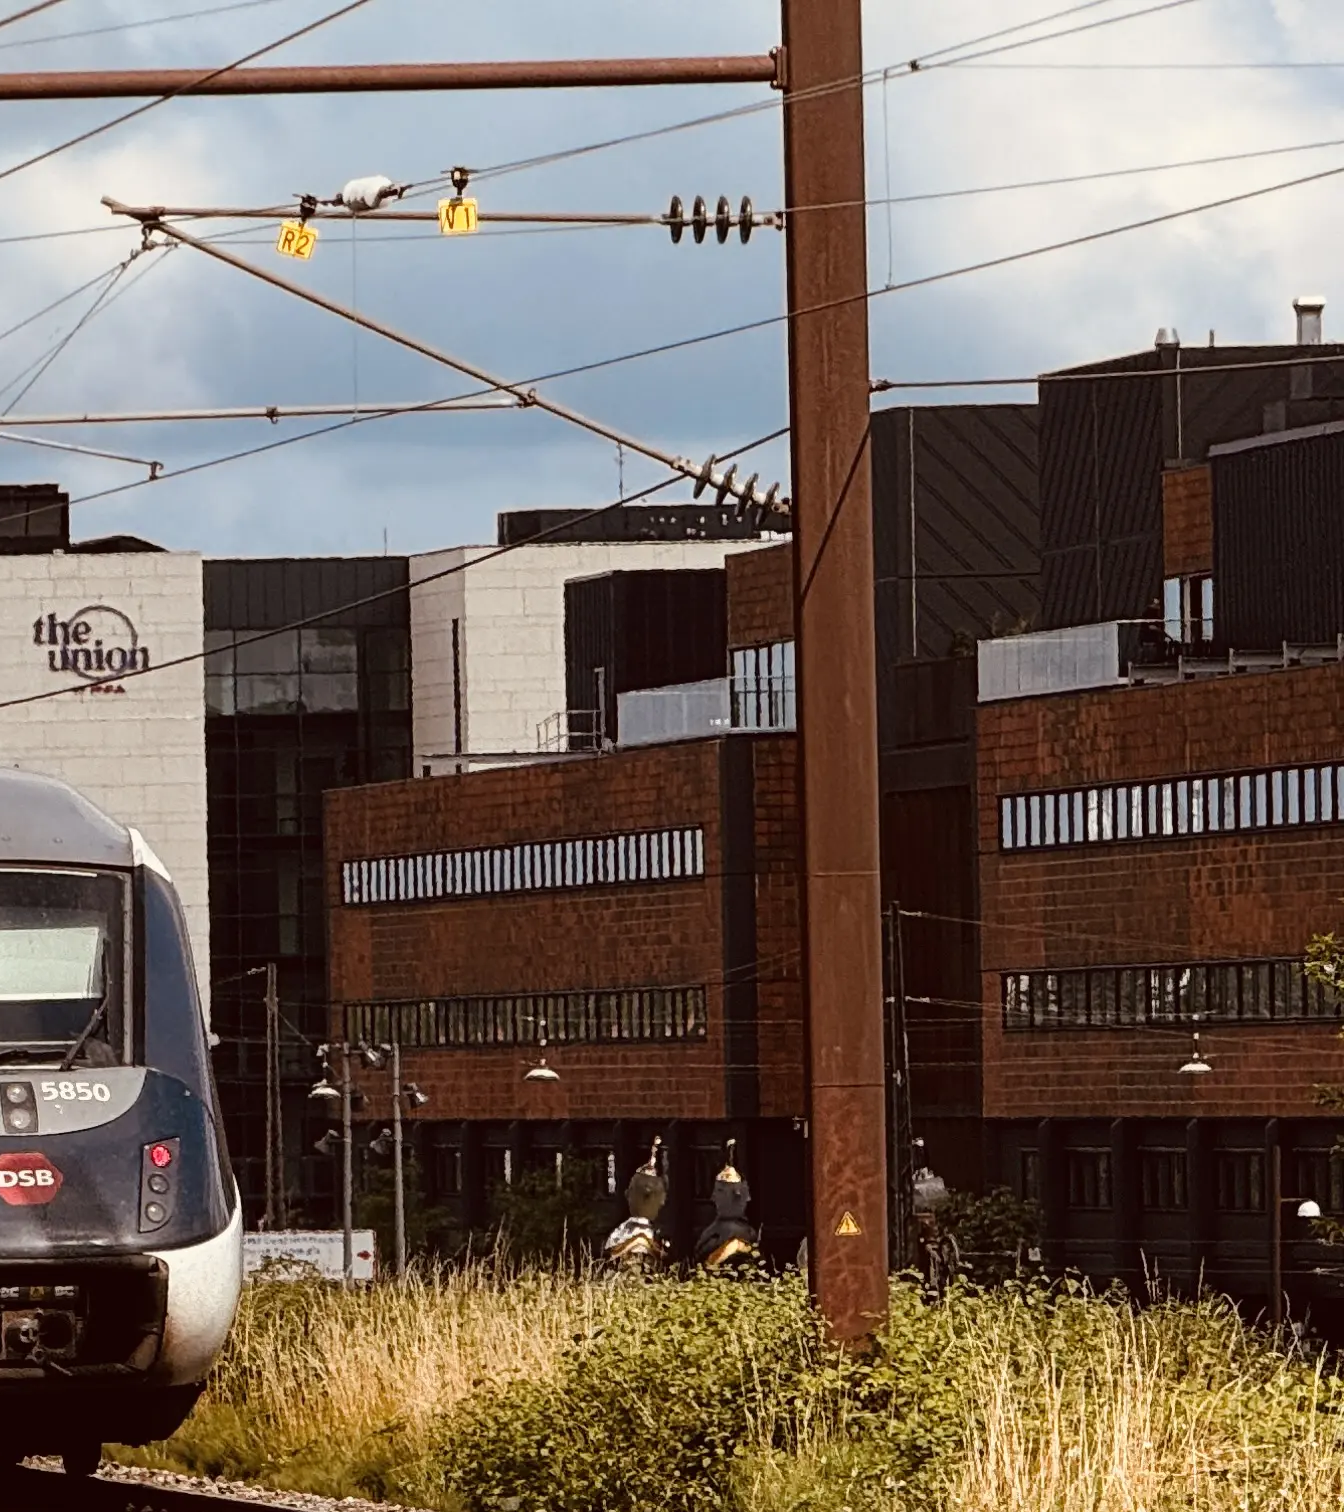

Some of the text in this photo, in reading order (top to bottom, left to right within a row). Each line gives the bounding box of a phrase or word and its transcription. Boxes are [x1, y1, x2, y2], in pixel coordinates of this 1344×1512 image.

[33, 612, 92, 646] the
[47, 639, 150, 673] union
[40, 1081, 111, 1102] 5850
